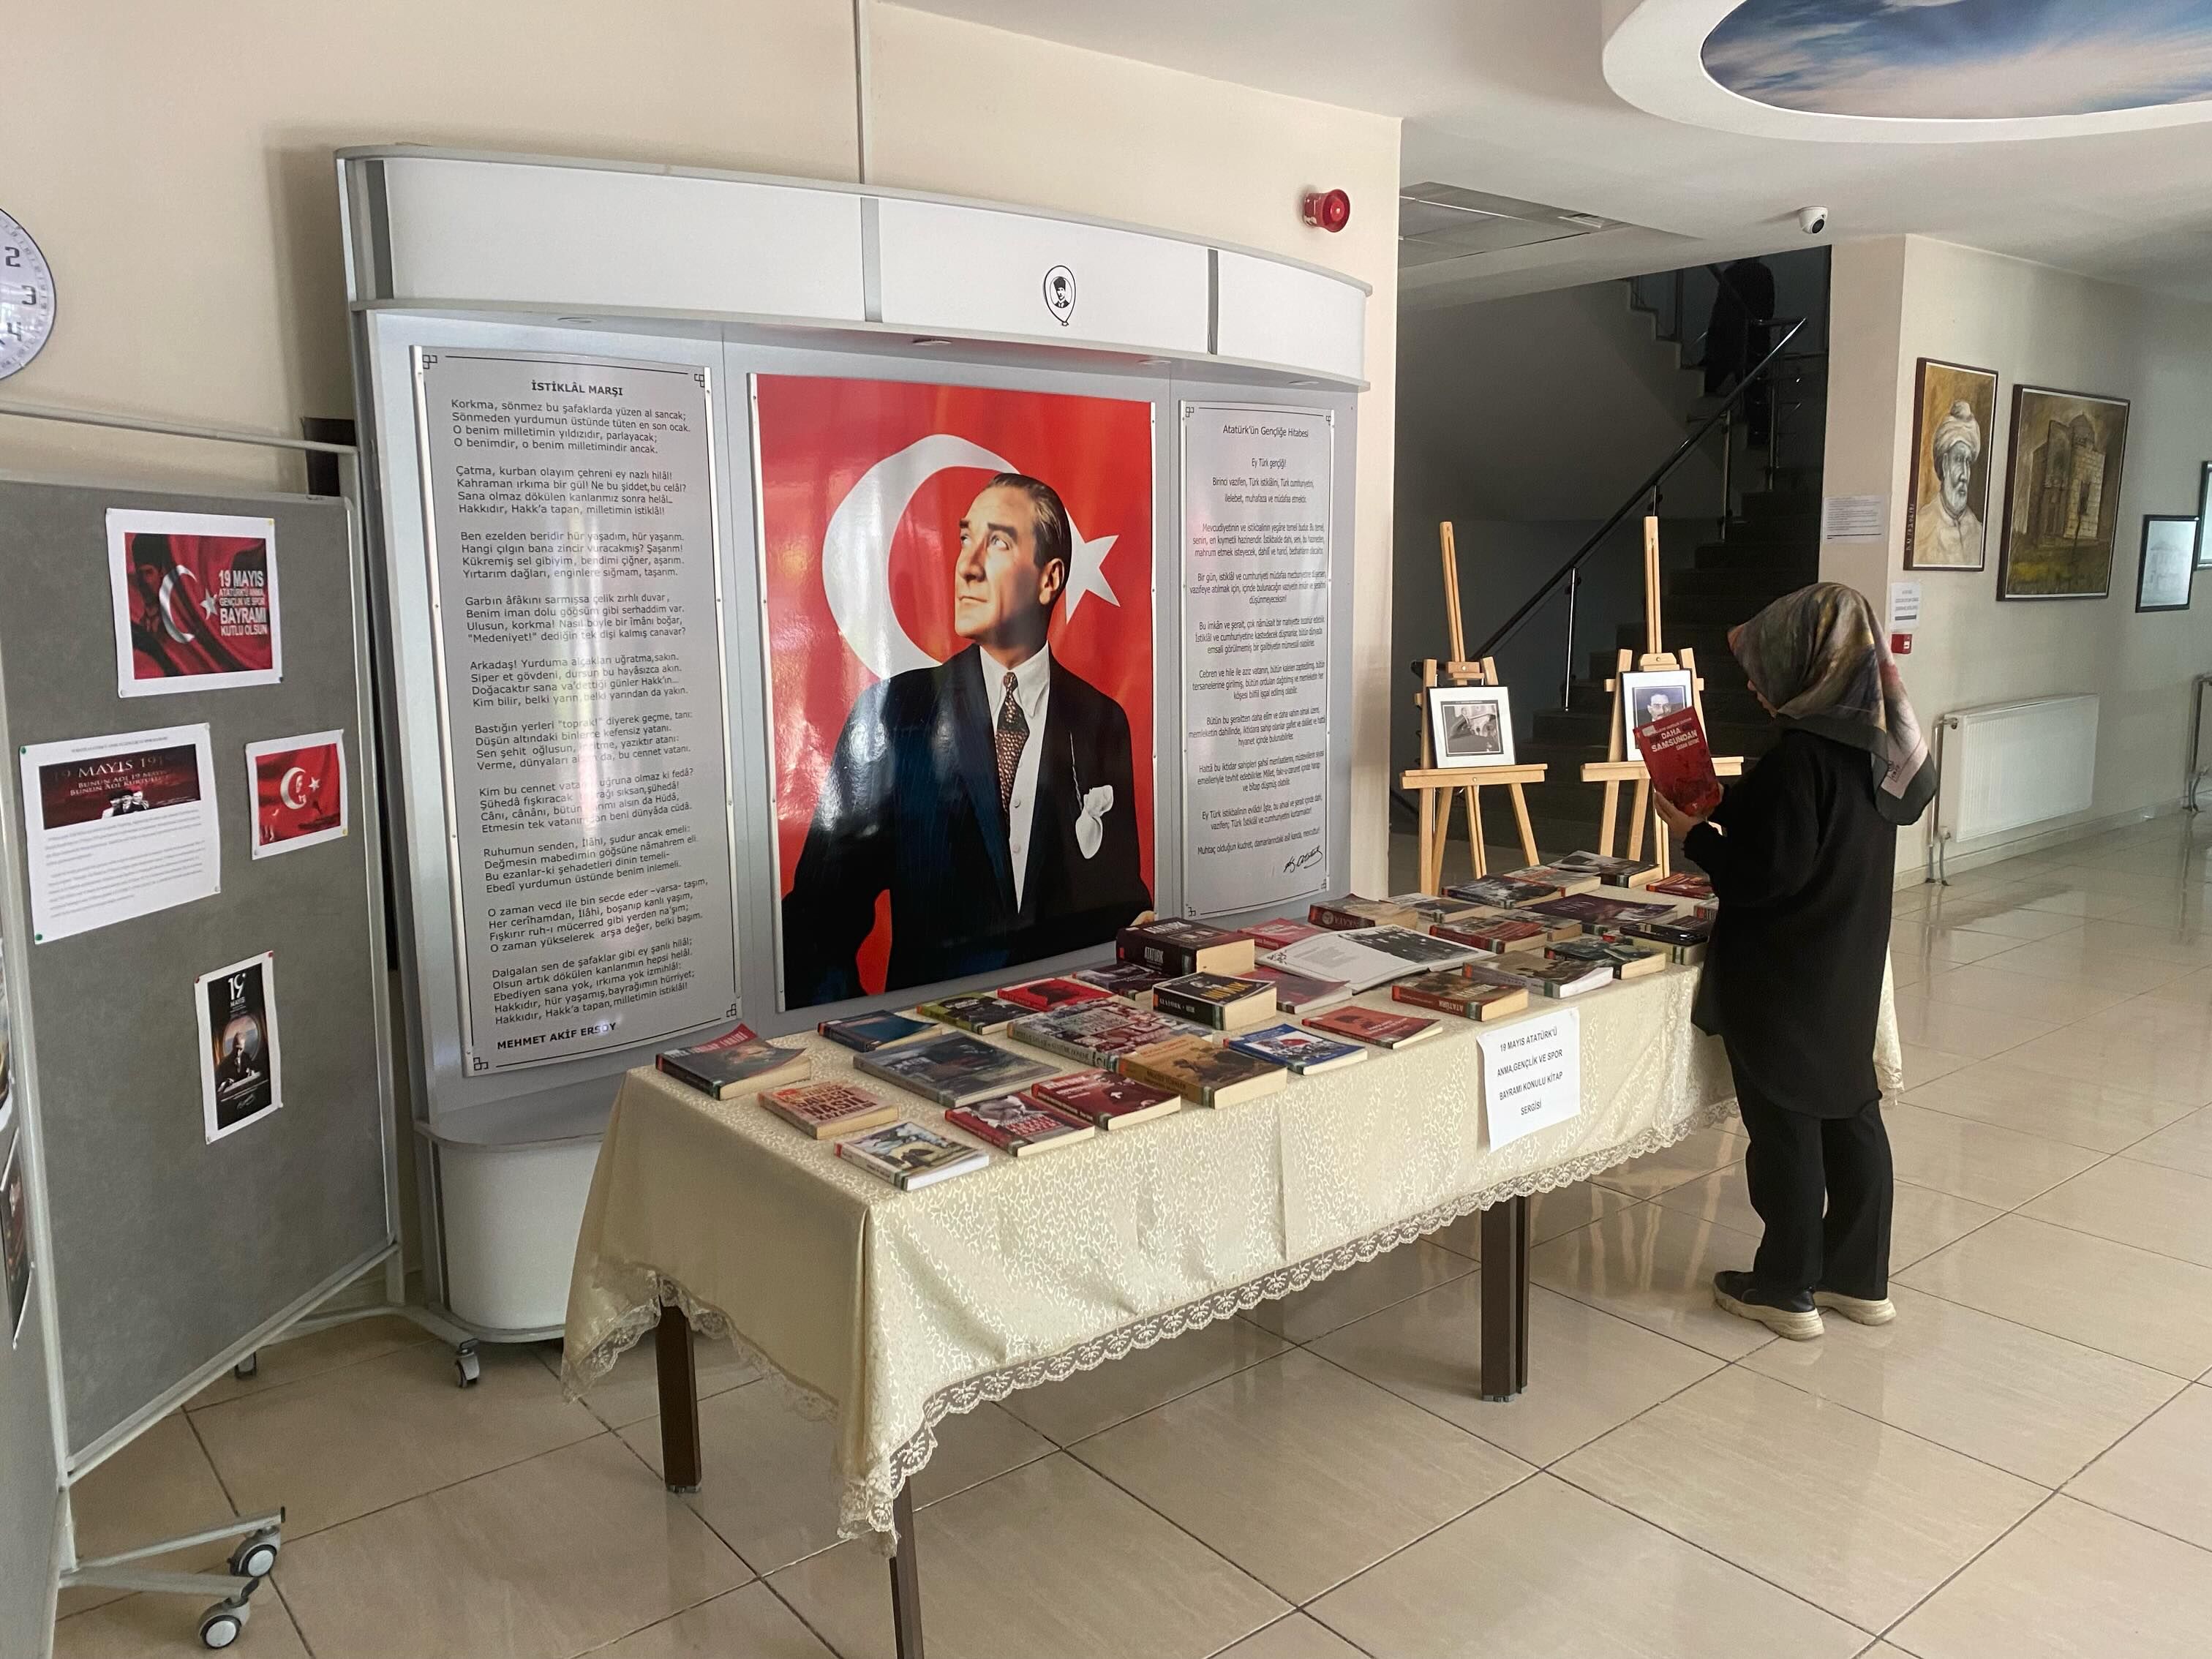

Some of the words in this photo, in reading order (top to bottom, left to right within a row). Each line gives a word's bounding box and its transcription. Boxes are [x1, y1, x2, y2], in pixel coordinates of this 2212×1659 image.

[4, 246, 20, 267] 2
[21, 285, 37, 305] 3
[531, 380, 585, 394] İSTİKLÂL
[588, 385, 622, 399] MARŞI
[451, 399, 498, 410] Korkma,
[501, 401, 545, 411] sönmez
[546, 403, 559, 412] bu
[561, 404, 613, 418] şafaklarda
[614, 407, 642, 419] yüzen
[643, 408, 652, 417] al
[654, 409, 685, 421] sancak;
[451, 413, 511, 422] Sönmeden
[514, 414, 569, 427] yurdumun
[571, 416, 610, 426] üstünde
[612, 418, 636, 428] tüten
[667, 422, 691, 432] ocak.
[1222, 425, 1259, 434] Atatürk'ün
[1260, 426, 1287, 437] Gençliğe
[1287, 428, 1309, 437] Hitabesi
[452, 425, 462, 434] O
[464, 425, 500, 434] benim
[503, 426, 557, 437] milletimin
[558, 429, 604, 442] yıldızıdır,
[606, 431, 657, 444] parlayacak;
[454, 438, 463, 446] O
[466, 438, 518, 449] benimdir,
[532, 440, 565, 449] benim
[567, 441, 627, 452] milletimindir
[629, 443, 658, 454] ancak.
[1251, 459, 1258, 468] Ey
[1269, 459, 1286, 469] gençliği!
[455, 467, 495, 478] Çatma,
[499, 467, 538, 475] kurban
[538, 467, 575, 479] olayım
[577, 468, 612, 480] çehreni
[614, 471, 626, 481] ey
[629, 470, 649, 479] nazlı
[651, 471, 672, 480] hilâl!
[1228, 478, 1248, 486] vazifen,
[459, 504, 508, 514] Hakkıdır,
[511, 505, 547, 513] Hakk'a
[584, 505, 632, 514] milletimin
[633, 505, 664, 514] istiklâl!
[219, 570, 230, 587] 19
[233, 571, 264, 587] MAYIS
[1205, 573, 1218, 583] gün,
[1242, 571, 1268, 582] cumhuriyeti
[464, 596, 504, 606] Garbın
[505, 595, 541, 604] âfâkını
[543, 596, 592, 606] sarmışsa
[616, 594, 639, 602] zırhlı
[641, 593, 669, 603] duvar,
[220, 607, 267, 624] BAYRAMI
[221, 625, 244, 636] KUTLU
[244, 625, 268, 635] OLSUN
[1651, 730, 1698, 752] SAMSUNDAN
[1660, 728, 1681, 740] DAHA
[78, 759, 132, 778] MAYIS
[140, 756, 164, 768] 191
[69, 786, 102, 796] BUNUN
[124, 774, 167, 787] KURTULU
[78, 779, 110, 789] BUNUN
[484, 856, 539, 872] Değmesin
[540, 849, 598, 864] mabedimin
[598, 843, 639, 859] göğsüne
[640, 836, 685, 851] nâmahrem
[685, 834, 698, 844] eli.
[487, 908, 497, 917] O
[497, 906, 535, 916] zaman
[537, 900, 562, 911] vecd
[565, 898, 578, 908] ile
[579, 895, 595, 906] bin
[598, 891, 626, 903] secde
[628, 887, 649, 898] eder
[683, 876, 708, 892] taşım,
[489, 919, 508, 929] Her
[511, 910, 575, 928] cerîhamdan,
[578, 904, 603, 919] İlâhi,
[606, 900, 642, 917] boşanıp
[644, 896, 664, 908] kanlı
[666, 892, 693, 906] yaşım,
[489, 928, 526, 944] Fışkırır
[528, 925, 553, 936] ruh-ı
[556, 917, 603, 933] mücerred
[606, 914, 624, 928] gibi
[626, 908, 656, 925] yerden
[490, 944, 499, 953] O
[501, 941, 538, 952] zaman
[539, 930, 595, 949] yükselerek
[600, 928, 622, 940] arşa
[623, 920, 652, 936] değer,
[655, 916, 674, 928] belki
[677, 911, 702, 926] başım.
[228, 974, 245, 1000] 19
[230, 996, 245, 1007] MAYIS
[1438, 1001, 1463, 1012] ATATÜRK
[497, 1034, 546, 1050] MEHMET
[549, 1027, 577, 1042] AKİF
[580, 1022, 616, 1037] ERSOY
[1500, 1043, 1507, 1052] 19
[1508, 1037, 1525, 1049] MAYIS
[1526, 1026, 1557, 1045] ATATÜRK'Ü
[1539, 1054, 1546, 1063] VE
[1547, 1049, 1563, 1061] SPOR
[1500, 1086, 1522, 1101] BAYRAMI
[1523, 1076, 1546, 1092] KONULU
[1547, 1071, 1563, 1083] KİTAP
[803, 1097, 869, 1116] NASIL
[1521, 1099, 1542, 1116] SERGİSİ
